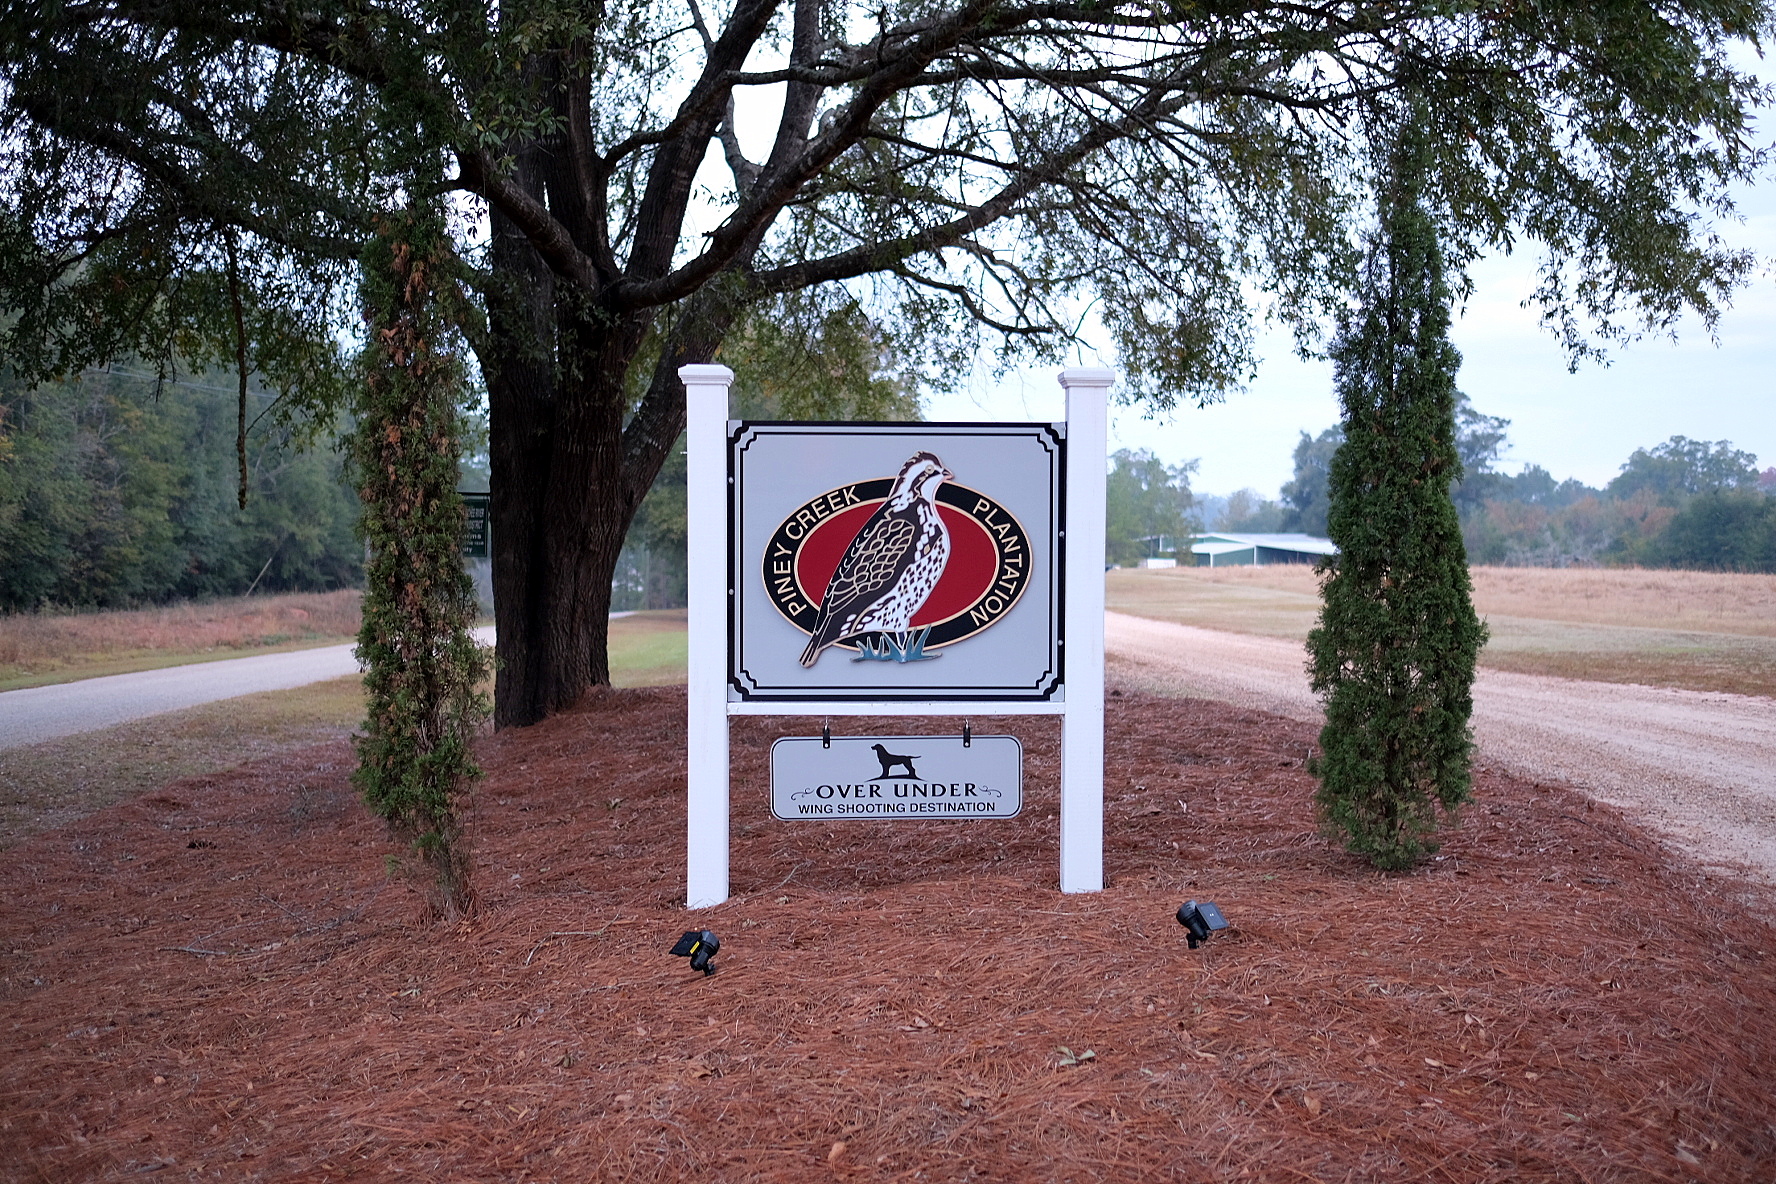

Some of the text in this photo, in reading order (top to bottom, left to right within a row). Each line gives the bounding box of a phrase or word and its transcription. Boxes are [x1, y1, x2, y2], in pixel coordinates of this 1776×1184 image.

[773, 486, 860, 617] PINEY CREEK
[971, 498, 1022, 627] PLANTATION
[798, 802, 996, 814] WING SHOOTING DESTINATION
[816, 782, 978, 799] OVER UNDER
